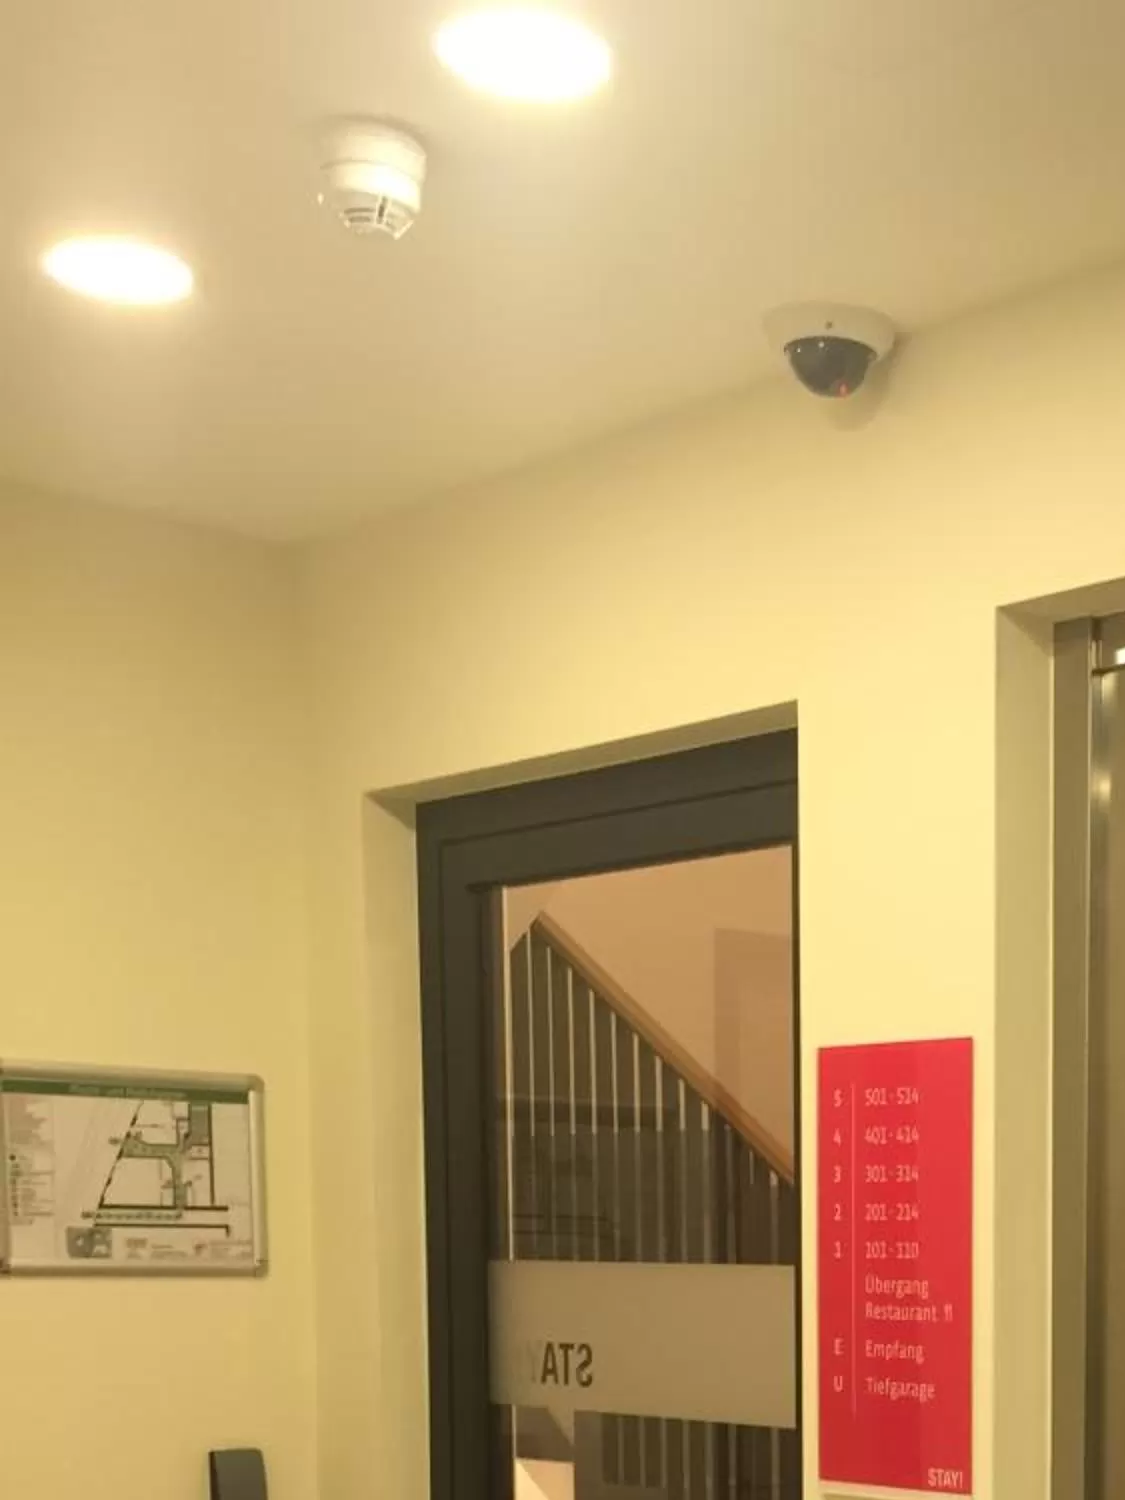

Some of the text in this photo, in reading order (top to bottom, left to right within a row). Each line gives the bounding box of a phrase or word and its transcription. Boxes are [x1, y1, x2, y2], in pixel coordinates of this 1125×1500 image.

[834, 1089, 842, 1107] 5
[833, 1128, 841, 1146] 4
[833, 1165, 841, 1183] 3
[833, 1203, 841, 1221] 2
[834, 1241, 842, 1259] 1
[865, 1273, 929, 1300] Übergang
[865, 1302, 938, 1322] Restaurant
[834, 1338, 925, 1364] E Empfang
[834, 1375, 935, 1401] U Tiefgarage
[928, 1468, 963, 1489] STAY!
